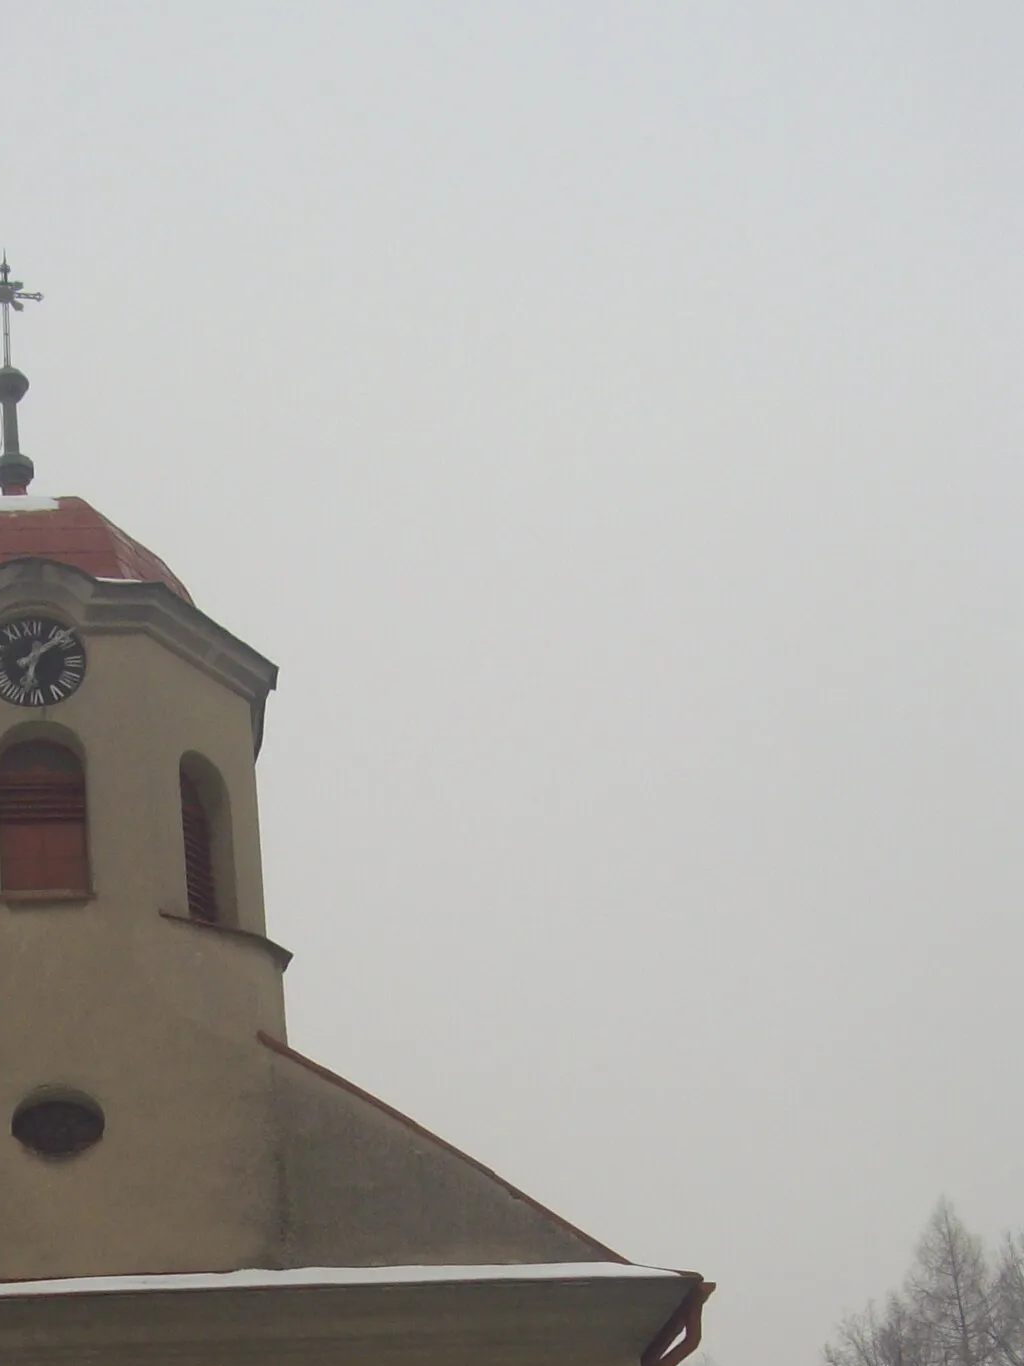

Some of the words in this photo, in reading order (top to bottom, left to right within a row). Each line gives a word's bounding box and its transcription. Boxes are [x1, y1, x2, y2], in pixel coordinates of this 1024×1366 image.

[2, 624, 21, 642] XI
[21, 620, 42, 637] XII
[64, 655, 82, 668] III
[30, 689, 44, 705] VI
[50, 684, 64, 700] V
